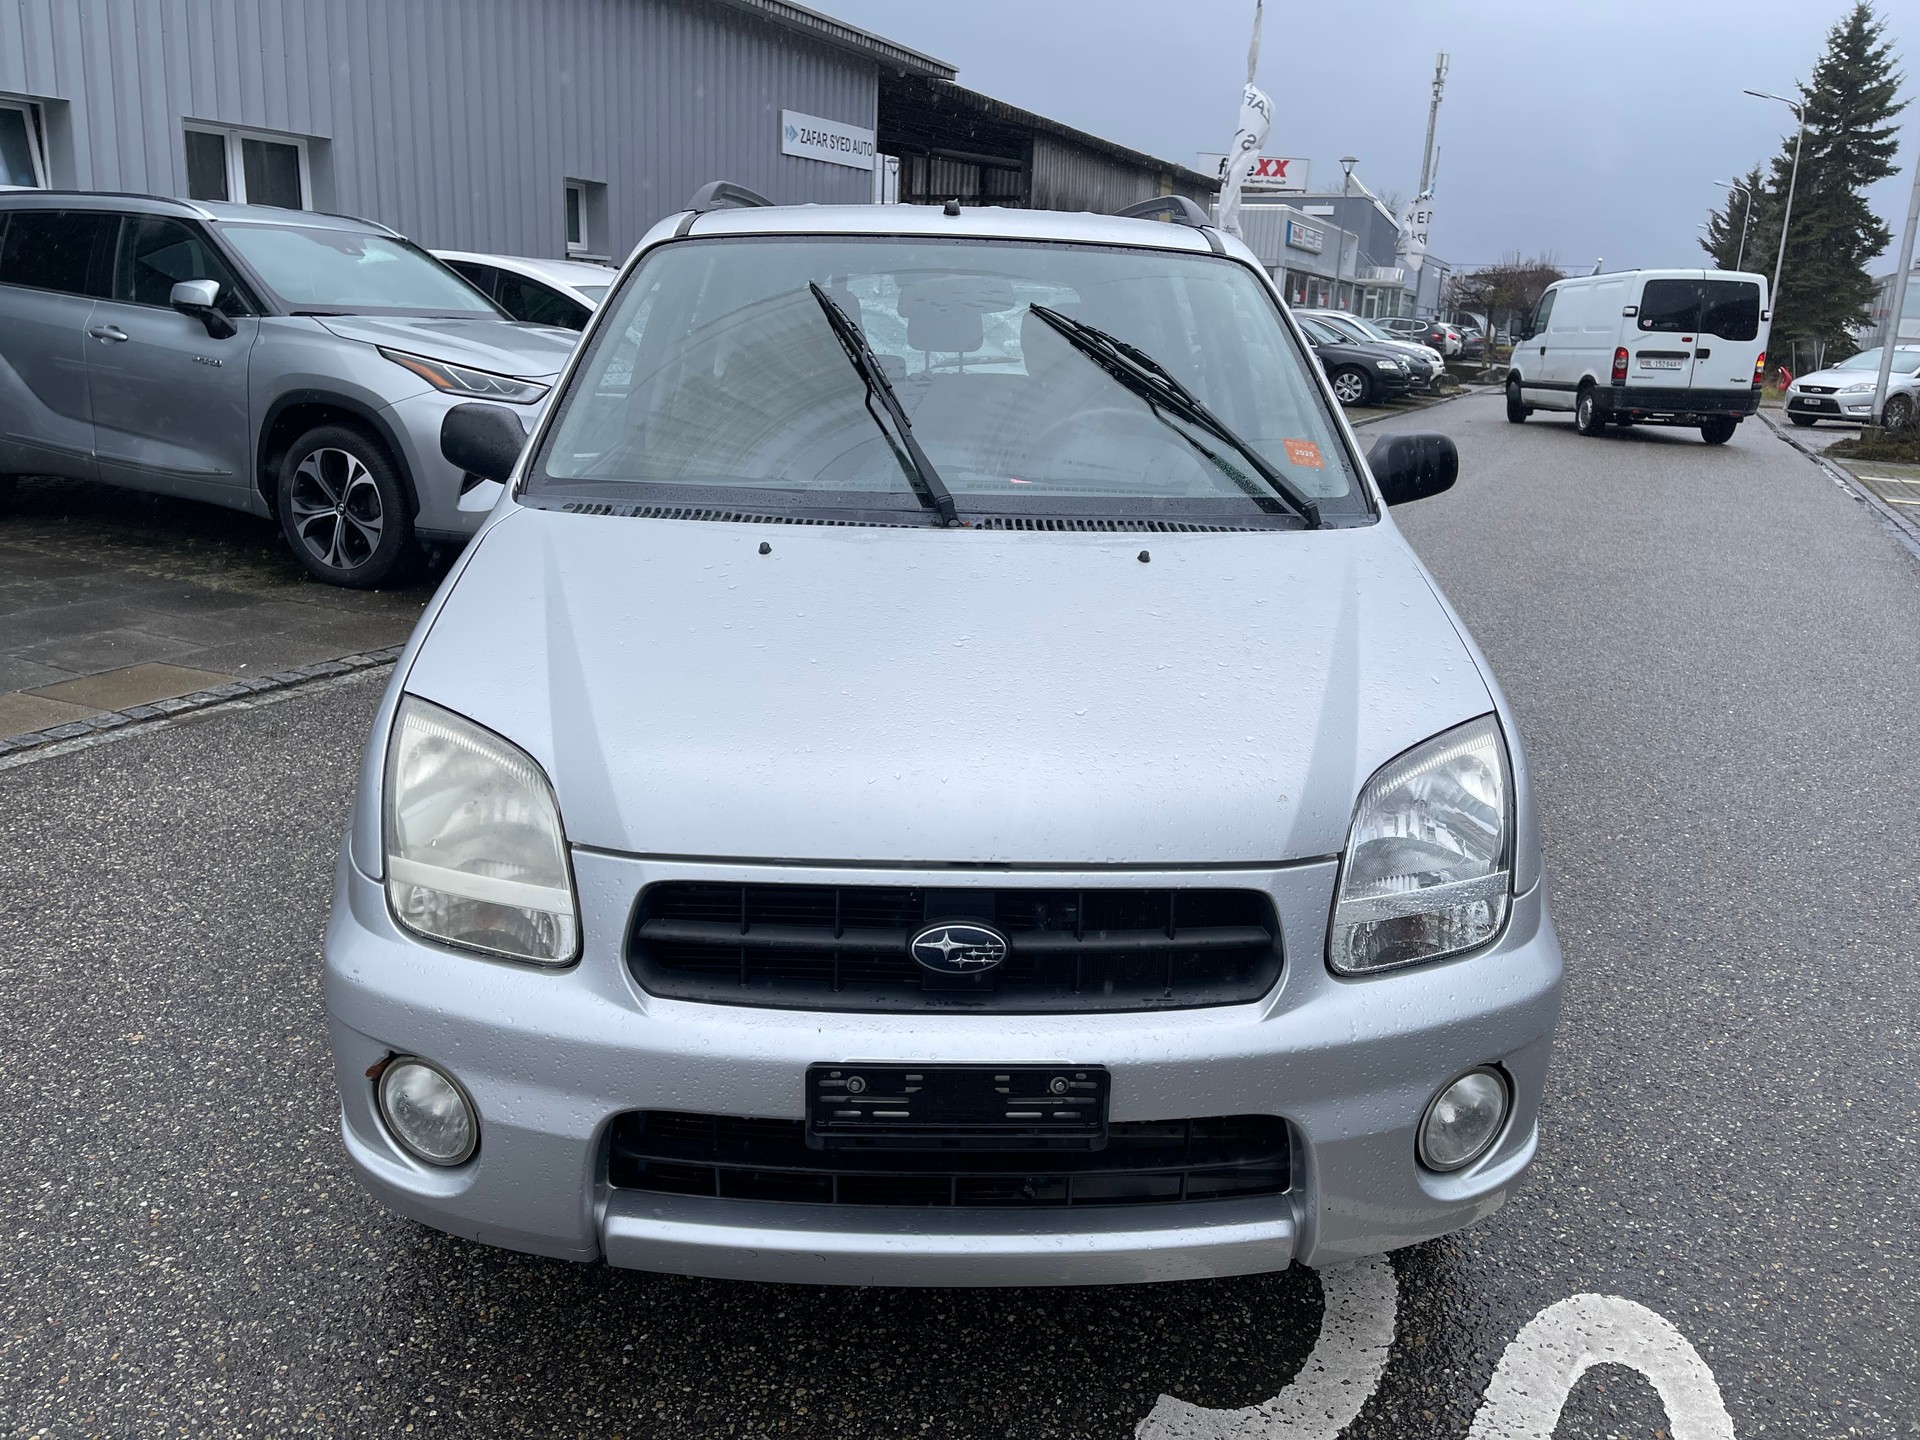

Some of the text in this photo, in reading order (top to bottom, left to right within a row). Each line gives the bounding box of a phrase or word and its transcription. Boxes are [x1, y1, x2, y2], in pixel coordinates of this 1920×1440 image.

[801, 128, 873, 157] ZAFAR SYED AUTO
[1294, 449, 1315, 458] 2025
